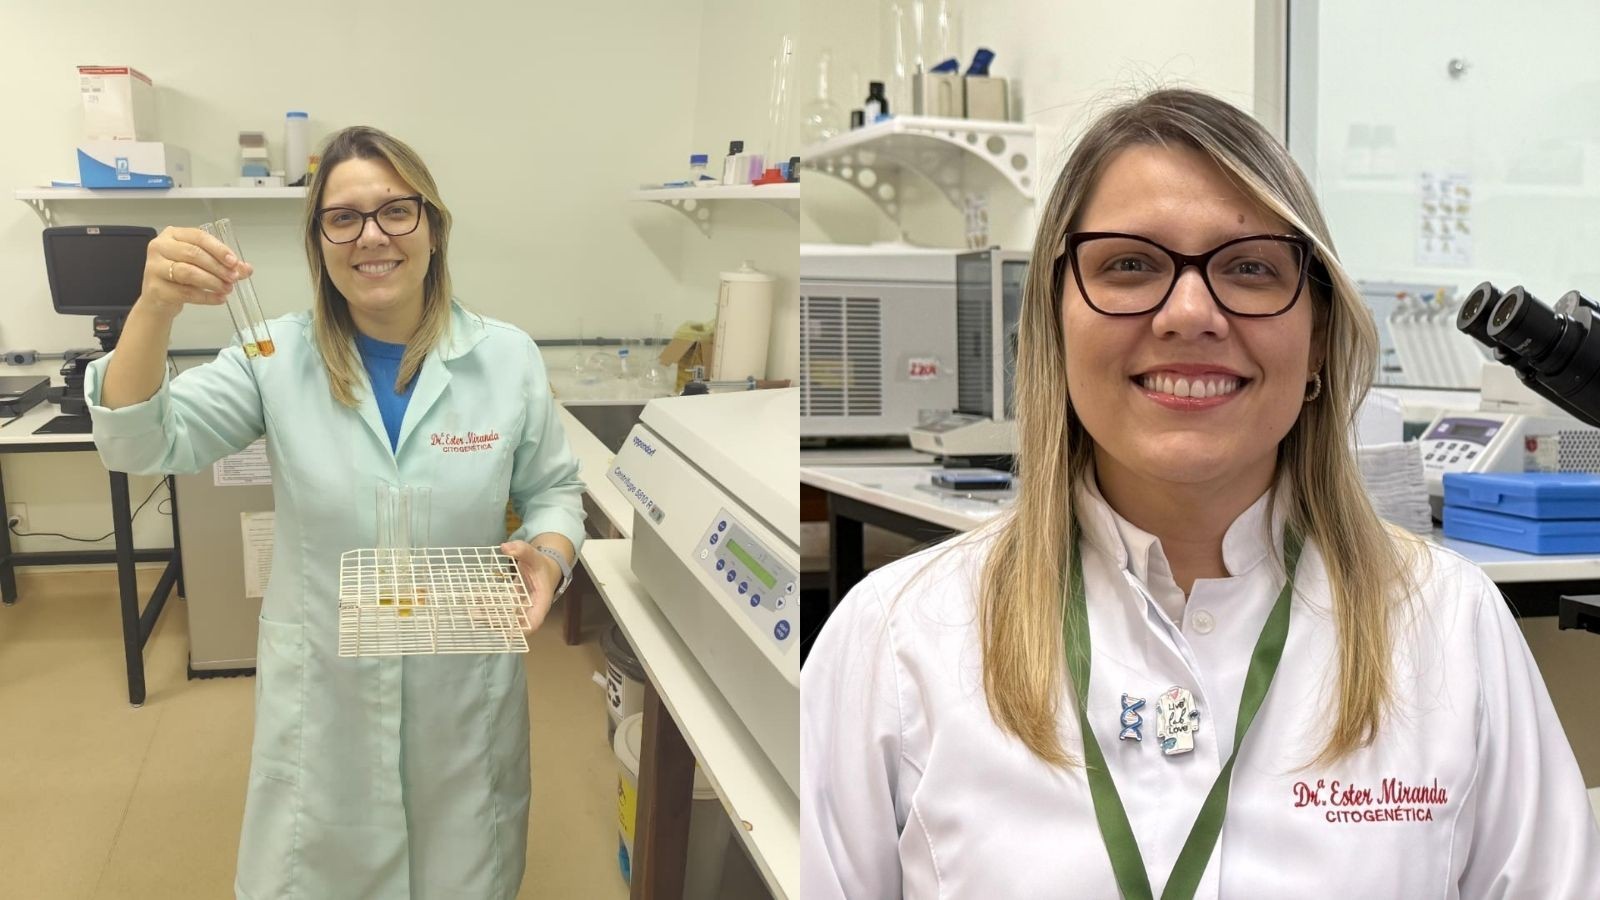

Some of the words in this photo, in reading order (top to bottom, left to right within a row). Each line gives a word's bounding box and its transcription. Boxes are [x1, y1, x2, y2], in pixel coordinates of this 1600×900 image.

[446, 433, 463, 445] Ester
[466, 430, 499, 444] Miranda
[443, 444, 492, 452] CITOGENÉTICA
[614, 466, 637, 493] Centrifuge
[634, 488, 649, 505] 5810
[645, 500, 654, 511] R
[1330, 780, 1373, 807] Ester
[1377, 777, 1448, 805] Miranda
[1325, 806, 1433, 823] CITOGENÉTICA
